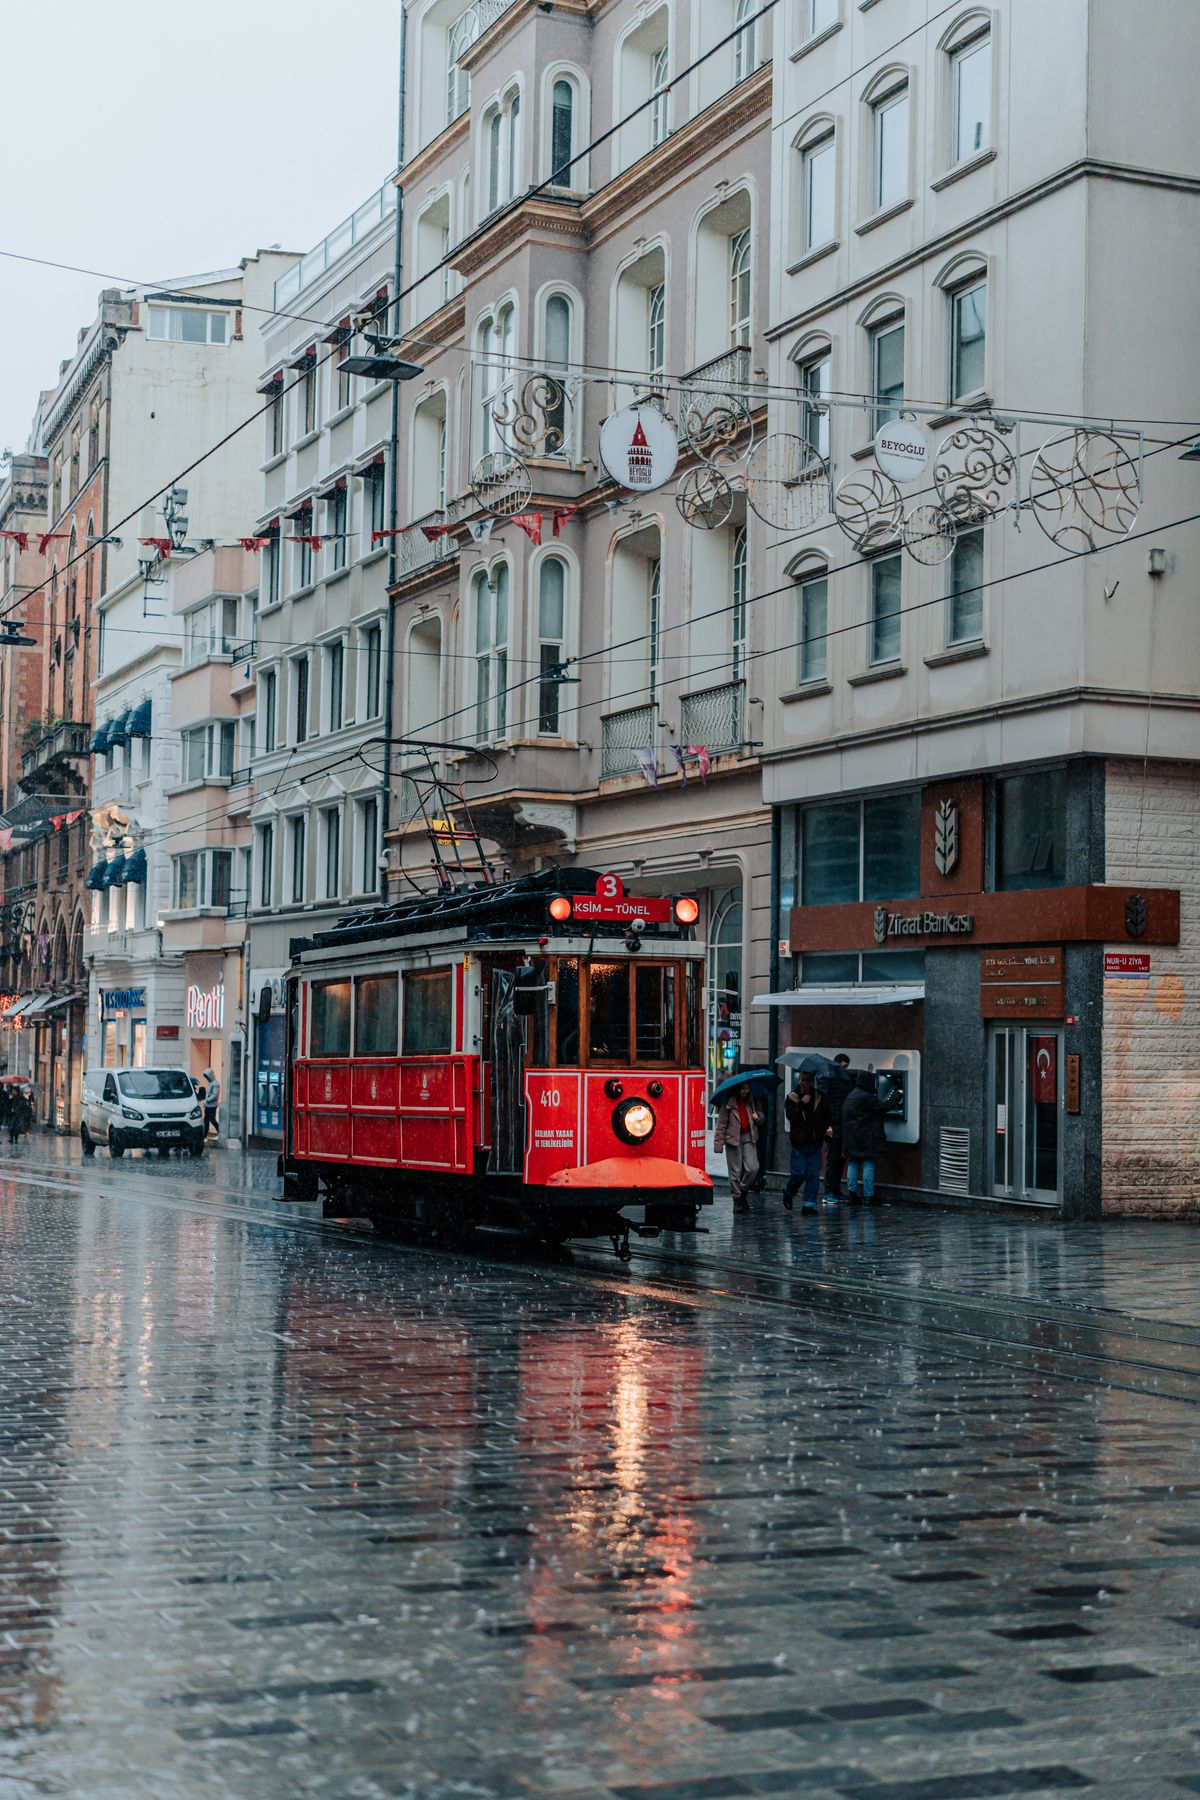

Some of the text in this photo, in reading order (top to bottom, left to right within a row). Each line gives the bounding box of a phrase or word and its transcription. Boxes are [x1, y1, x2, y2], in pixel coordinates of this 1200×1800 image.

[881, 440, 925, 456] BEYOĞLU
[603, 876, 617, 897] 3
[573, 901, 602, 913] KSİM
[615, 903, 650, 915] TÜNEL
[887, 913, 922, 935] Ziraat
[1106, 956, 1143, 966] NUR-U ZİYA
[187, 984, 225, 1029] Penti
[540, 1090, 560, 1107] 410
[555, 1130, 574, 1138] YASAK
